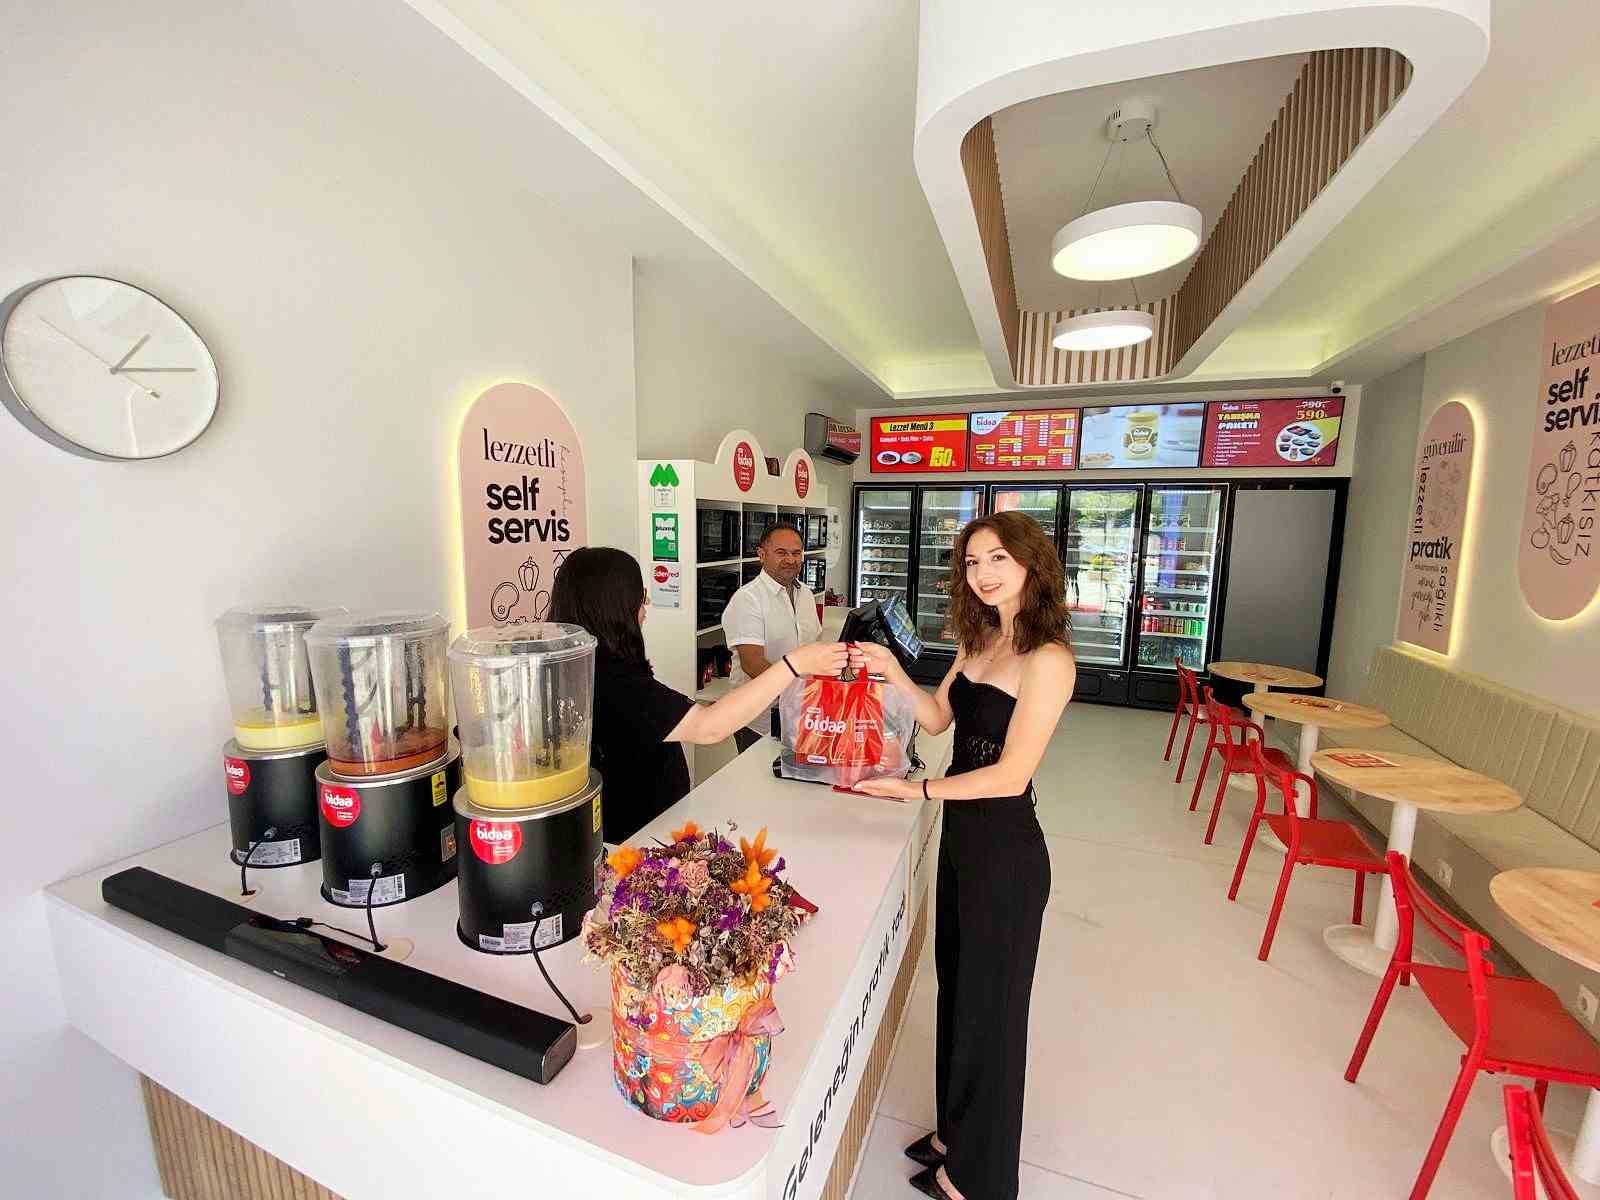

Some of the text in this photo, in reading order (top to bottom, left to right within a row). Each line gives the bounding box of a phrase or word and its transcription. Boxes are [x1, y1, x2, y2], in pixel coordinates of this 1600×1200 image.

[1547, 366, 1590, 405] self
[929, 421, 935, 431] 3
[1544, 392, 1600, 432] servi
[482, 427, 556, 469] lezzetli
[486, 475, 540, 511] self
[488, 509, 570, 544] servis
[1410, 536, 1453, 562] pratik
[804, 713, 847, 734] bidaa
[324, 792, 353, 807] bidaa
[476, 826, 512, 840] bidaa
[861, 933, 889, 1028] pratik
